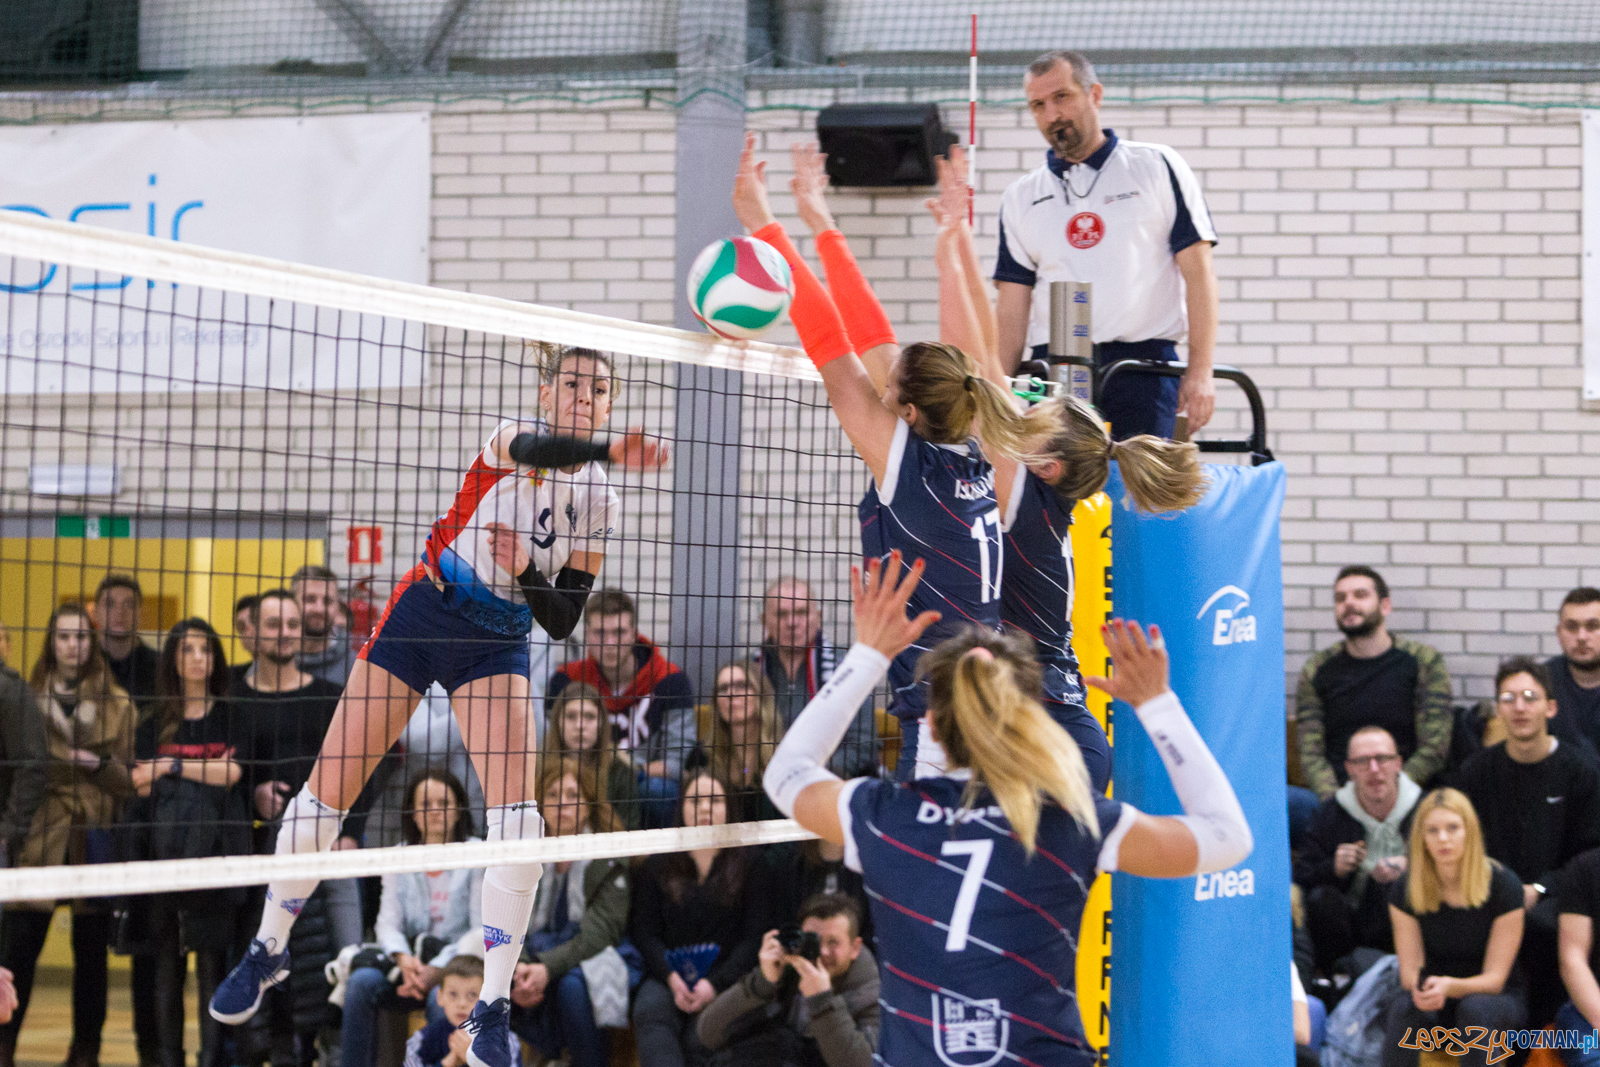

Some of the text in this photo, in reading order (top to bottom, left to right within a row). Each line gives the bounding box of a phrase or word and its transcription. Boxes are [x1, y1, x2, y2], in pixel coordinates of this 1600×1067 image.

[970, 507, 1004, 604] 17
[941, 839, 995, 952] 7
[1194, 868, 1255, 902] Enea
